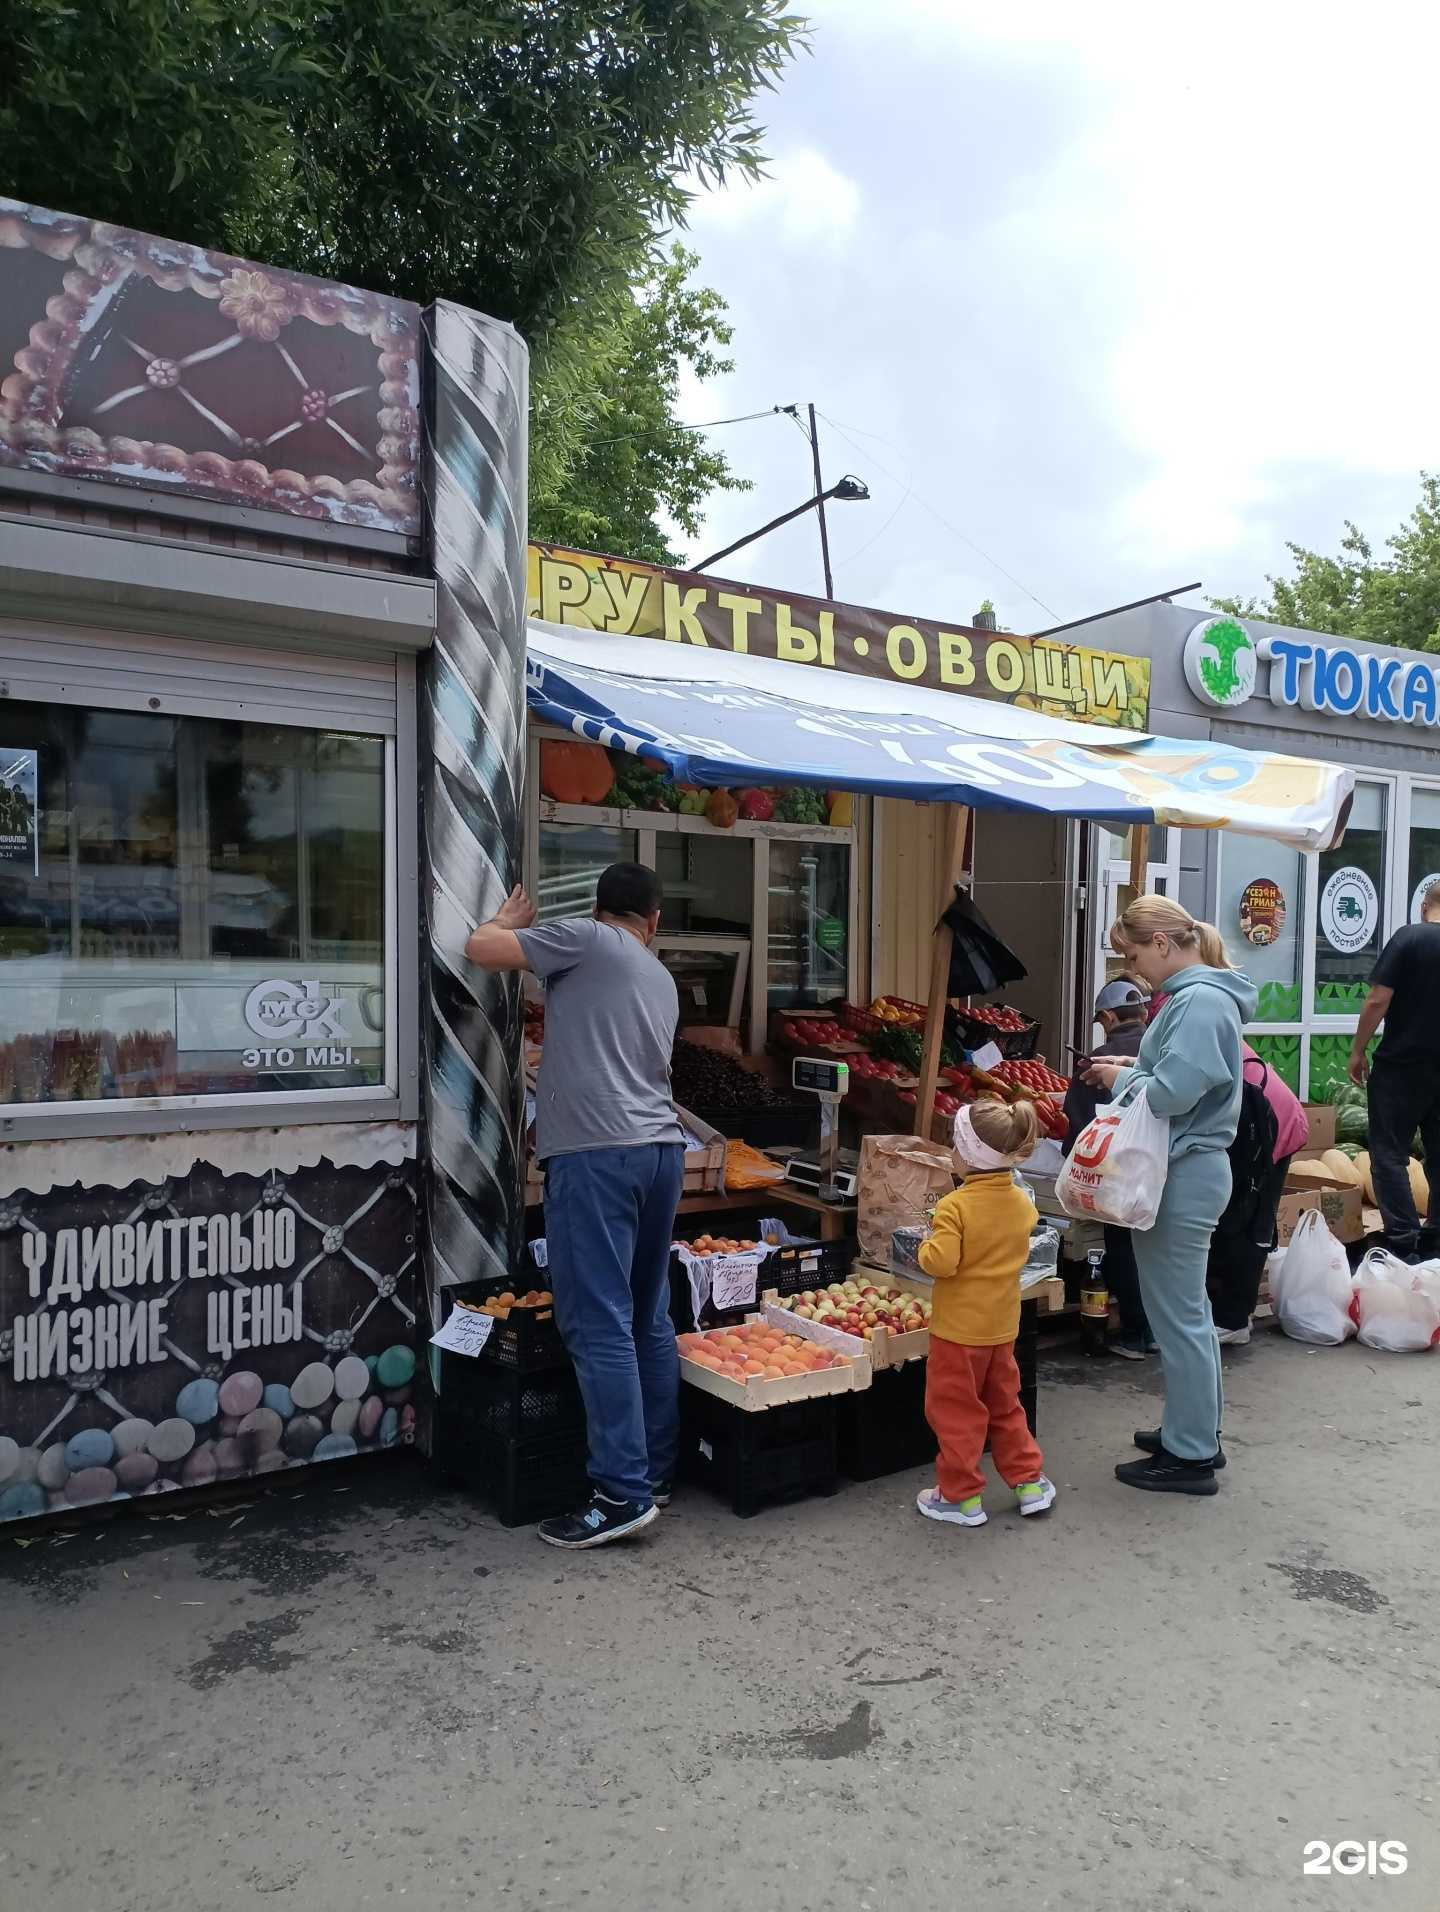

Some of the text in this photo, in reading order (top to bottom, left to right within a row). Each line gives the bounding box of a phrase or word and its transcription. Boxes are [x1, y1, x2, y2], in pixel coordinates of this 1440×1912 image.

[531, 557, 1130, 716] РУКТЫ ОВОЩИ
[1269, 639, 1440, 728] ТЮКА
[1327, 871, 1375, 900] ежедневные
[1330, 928, 1369, 948] поставки
[1069, 1167, 1104, 1185] МАГНИТ
[22, 1207, 296, 1305] УДИВИТЕЛЬНО
[13, 1282, 302, 1382] НИЗКИЕ ЦЕНЫ
